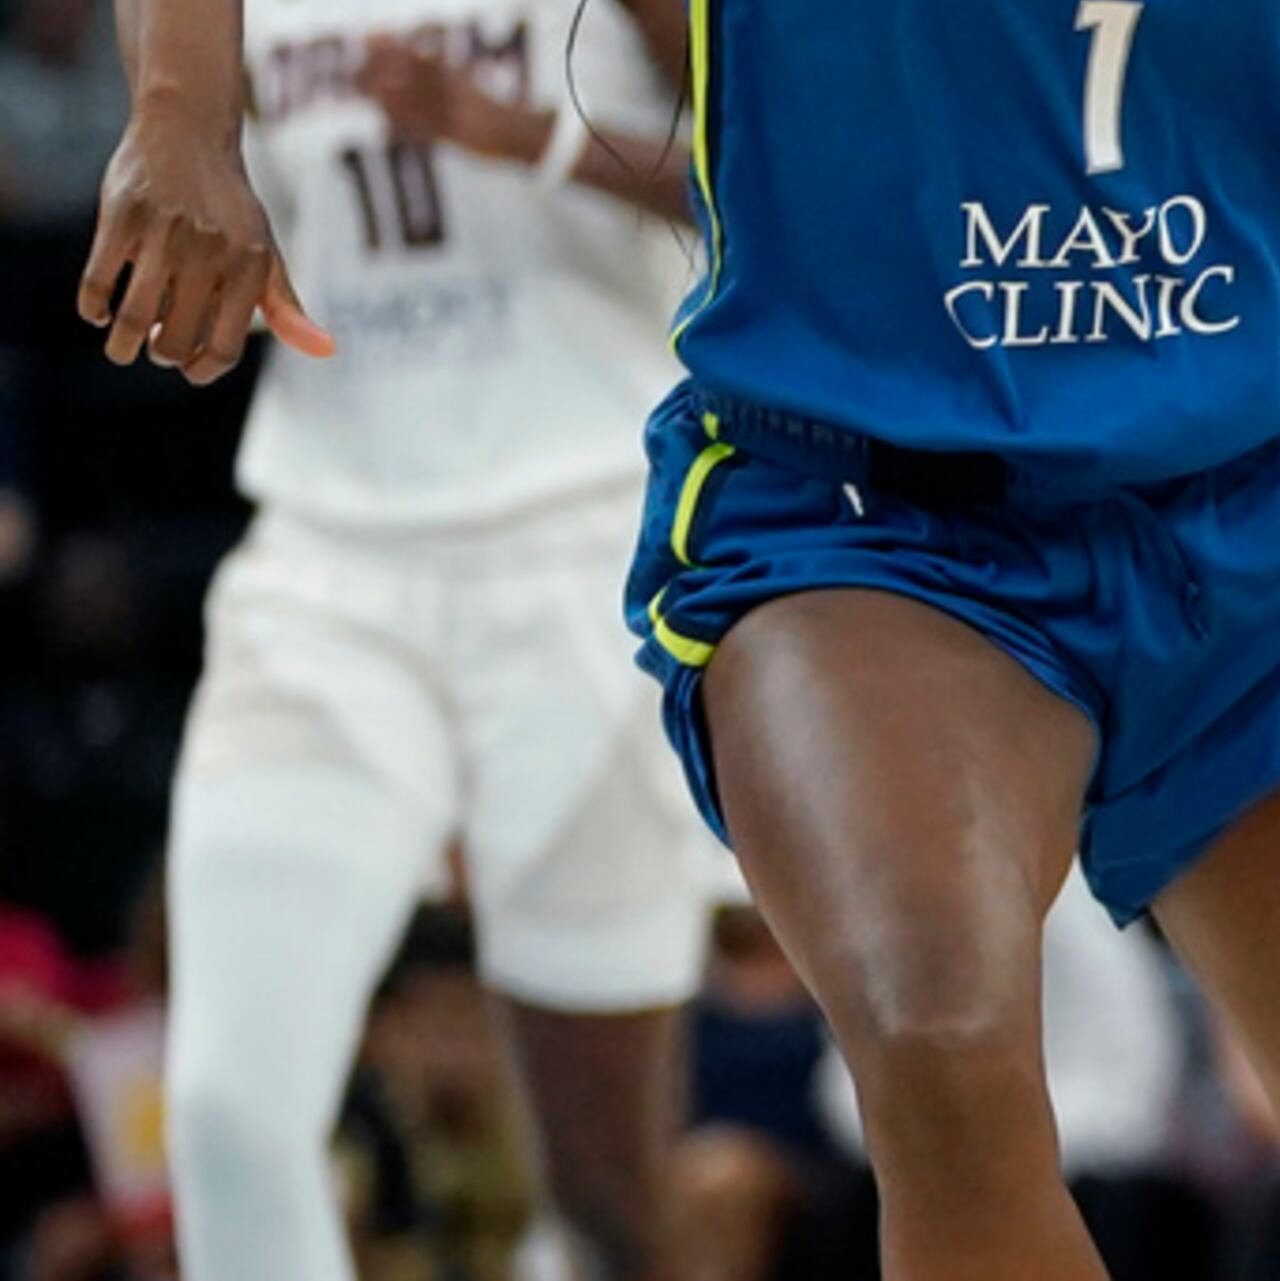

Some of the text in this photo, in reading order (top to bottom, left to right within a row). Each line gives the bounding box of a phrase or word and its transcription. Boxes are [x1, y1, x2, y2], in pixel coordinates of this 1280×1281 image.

[336, 136, 448, 256] 10
[959, 194, 1207, 269] MAYO
[943, 265, 1240, 349] CLINIC
